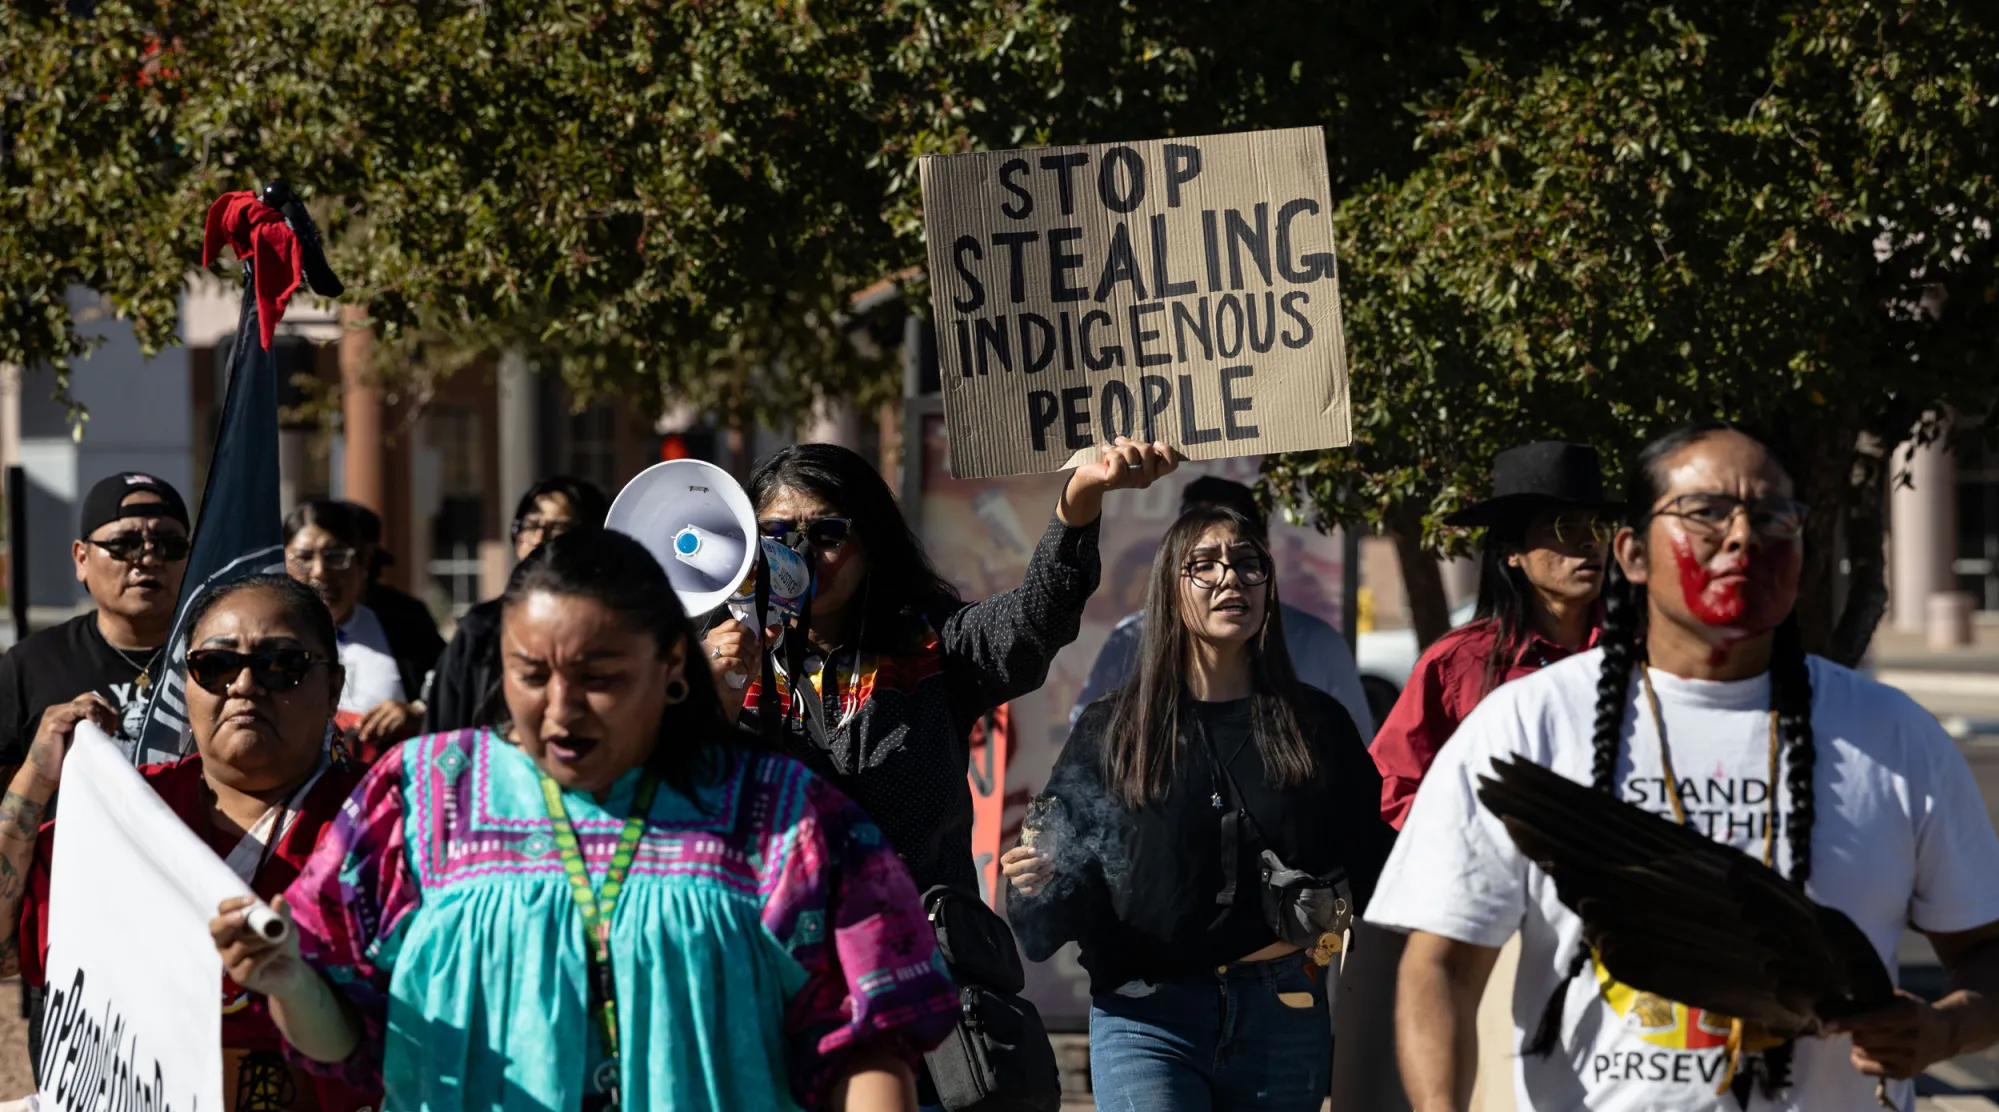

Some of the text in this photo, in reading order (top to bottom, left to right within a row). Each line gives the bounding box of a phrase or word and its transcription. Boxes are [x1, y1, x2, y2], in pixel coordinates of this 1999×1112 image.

[1000, 143, 1201, 219] STOP
[953, 198, 1335, 314] STEALING
[953, 291, 1313, 377] INDIGENOUS
[1027, 365, 1259, 452] PEOPLE
[1629, 778, 1769, 804] STAND
